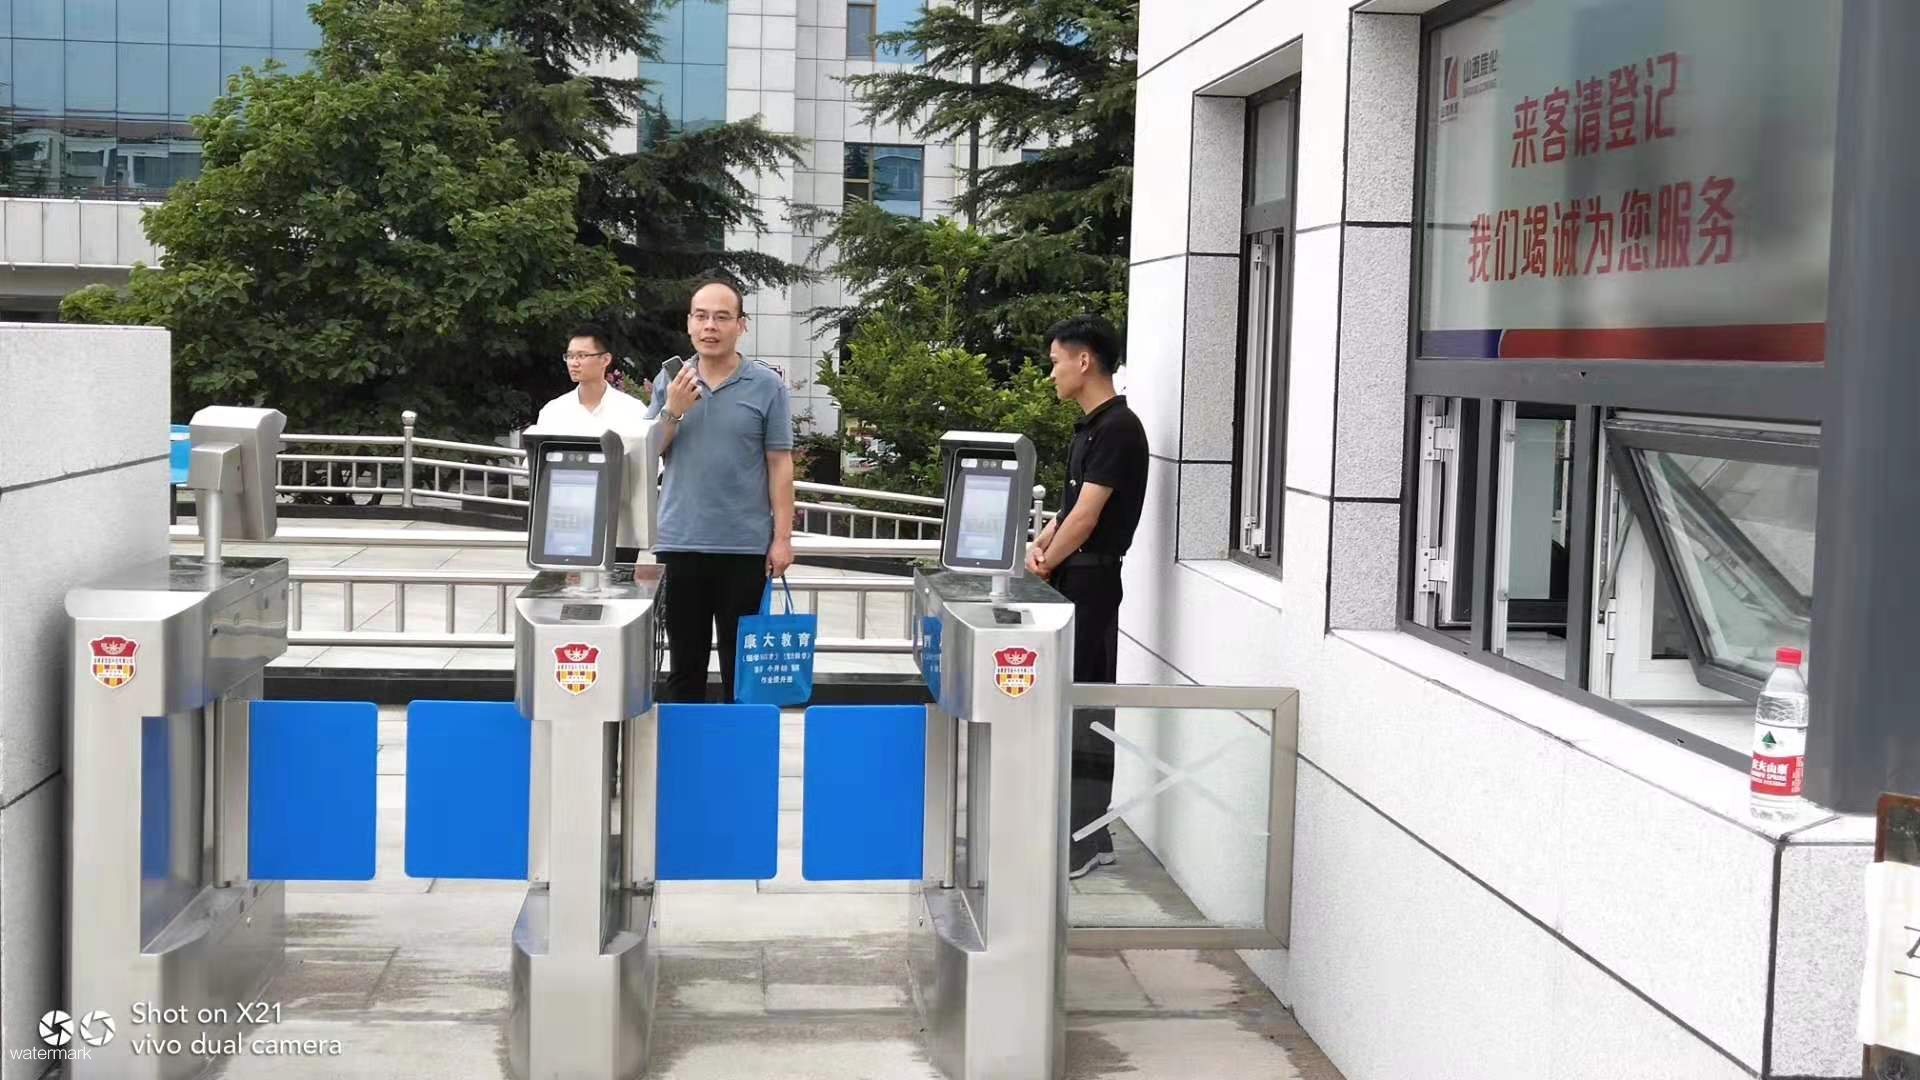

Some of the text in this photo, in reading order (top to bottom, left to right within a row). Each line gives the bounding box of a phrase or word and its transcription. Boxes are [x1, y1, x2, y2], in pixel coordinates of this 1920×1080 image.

[1511, 51, 1679, 168] 来客请登记
[1468, 175, 1737, 283] 我们竭诚为您服务
[743, 632, 811, 649] 康大教育
